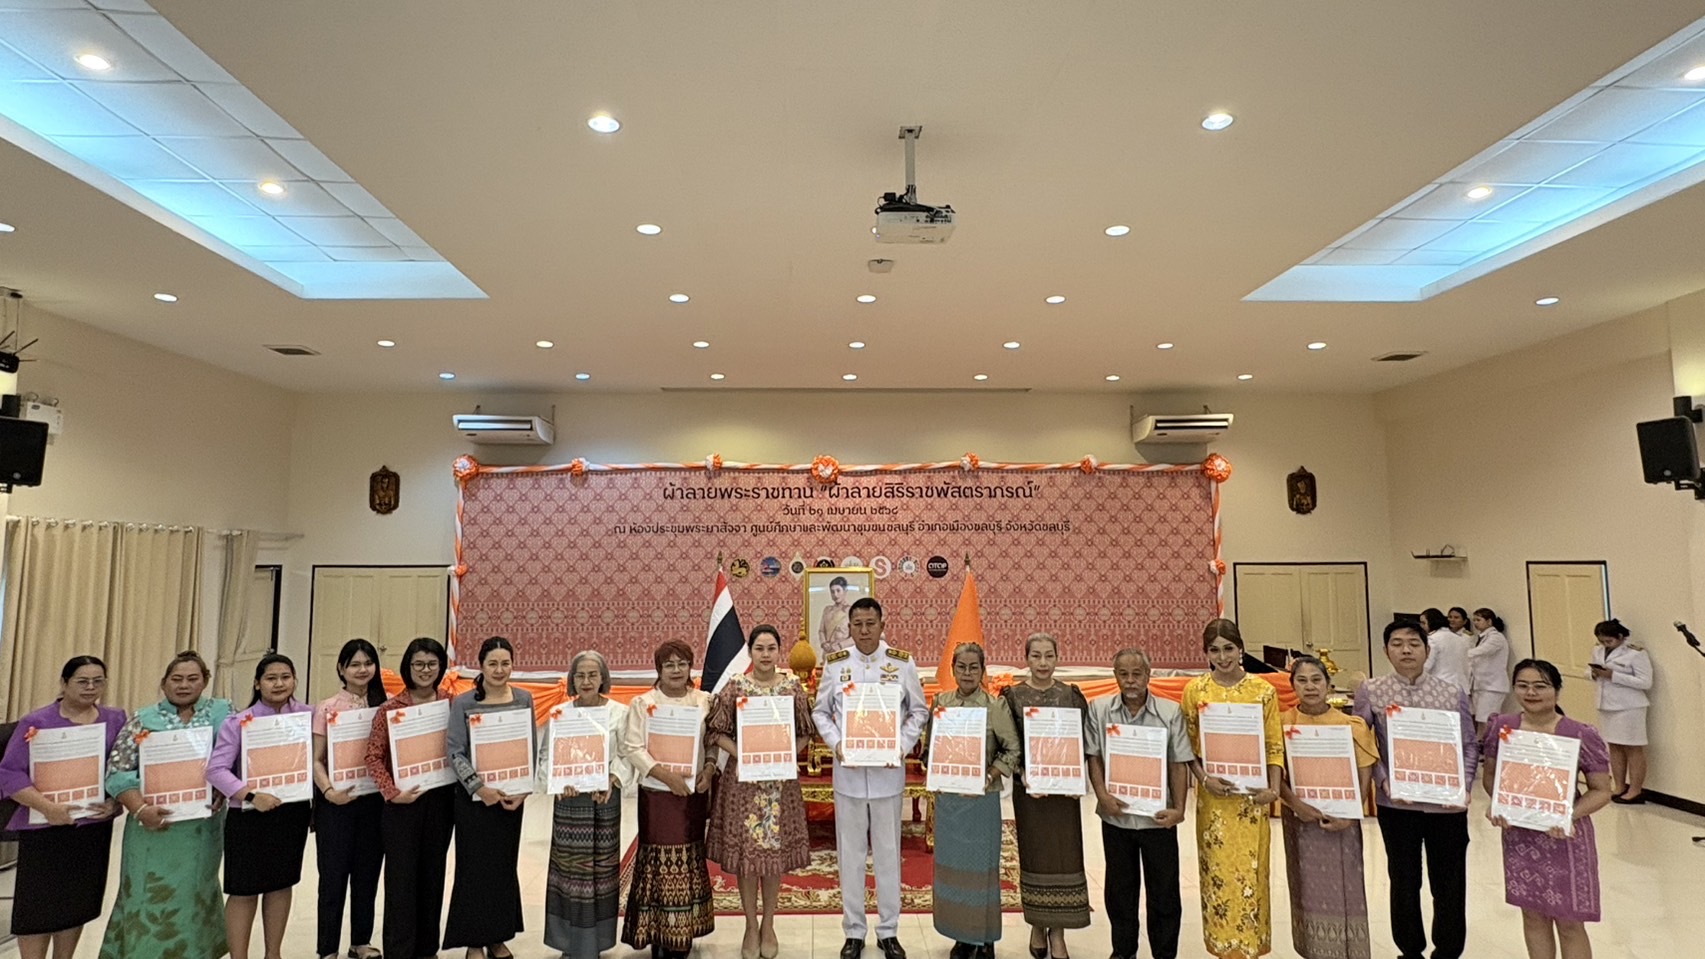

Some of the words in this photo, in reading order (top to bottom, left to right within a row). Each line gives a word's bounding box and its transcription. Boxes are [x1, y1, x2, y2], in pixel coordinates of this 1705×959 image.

[663, 483, 814, 500] ผ้าลายพระราชทาน
[782, 502, 806, 516] วันที่
[808, 506, 824, 517] ๒๑
[827, 506, 867, 516] เมษายน
[614, 525, 626, 535] ณ
[750, 521, 915, 537] ศูนย์ศึกษาและพัฒนาชุมชนชลบุรี
[918, 520, 1003, 537] อำเภอเมืองชลบุรี
[1006, 520, 1071, 537] จังหวัดชลบุรี
